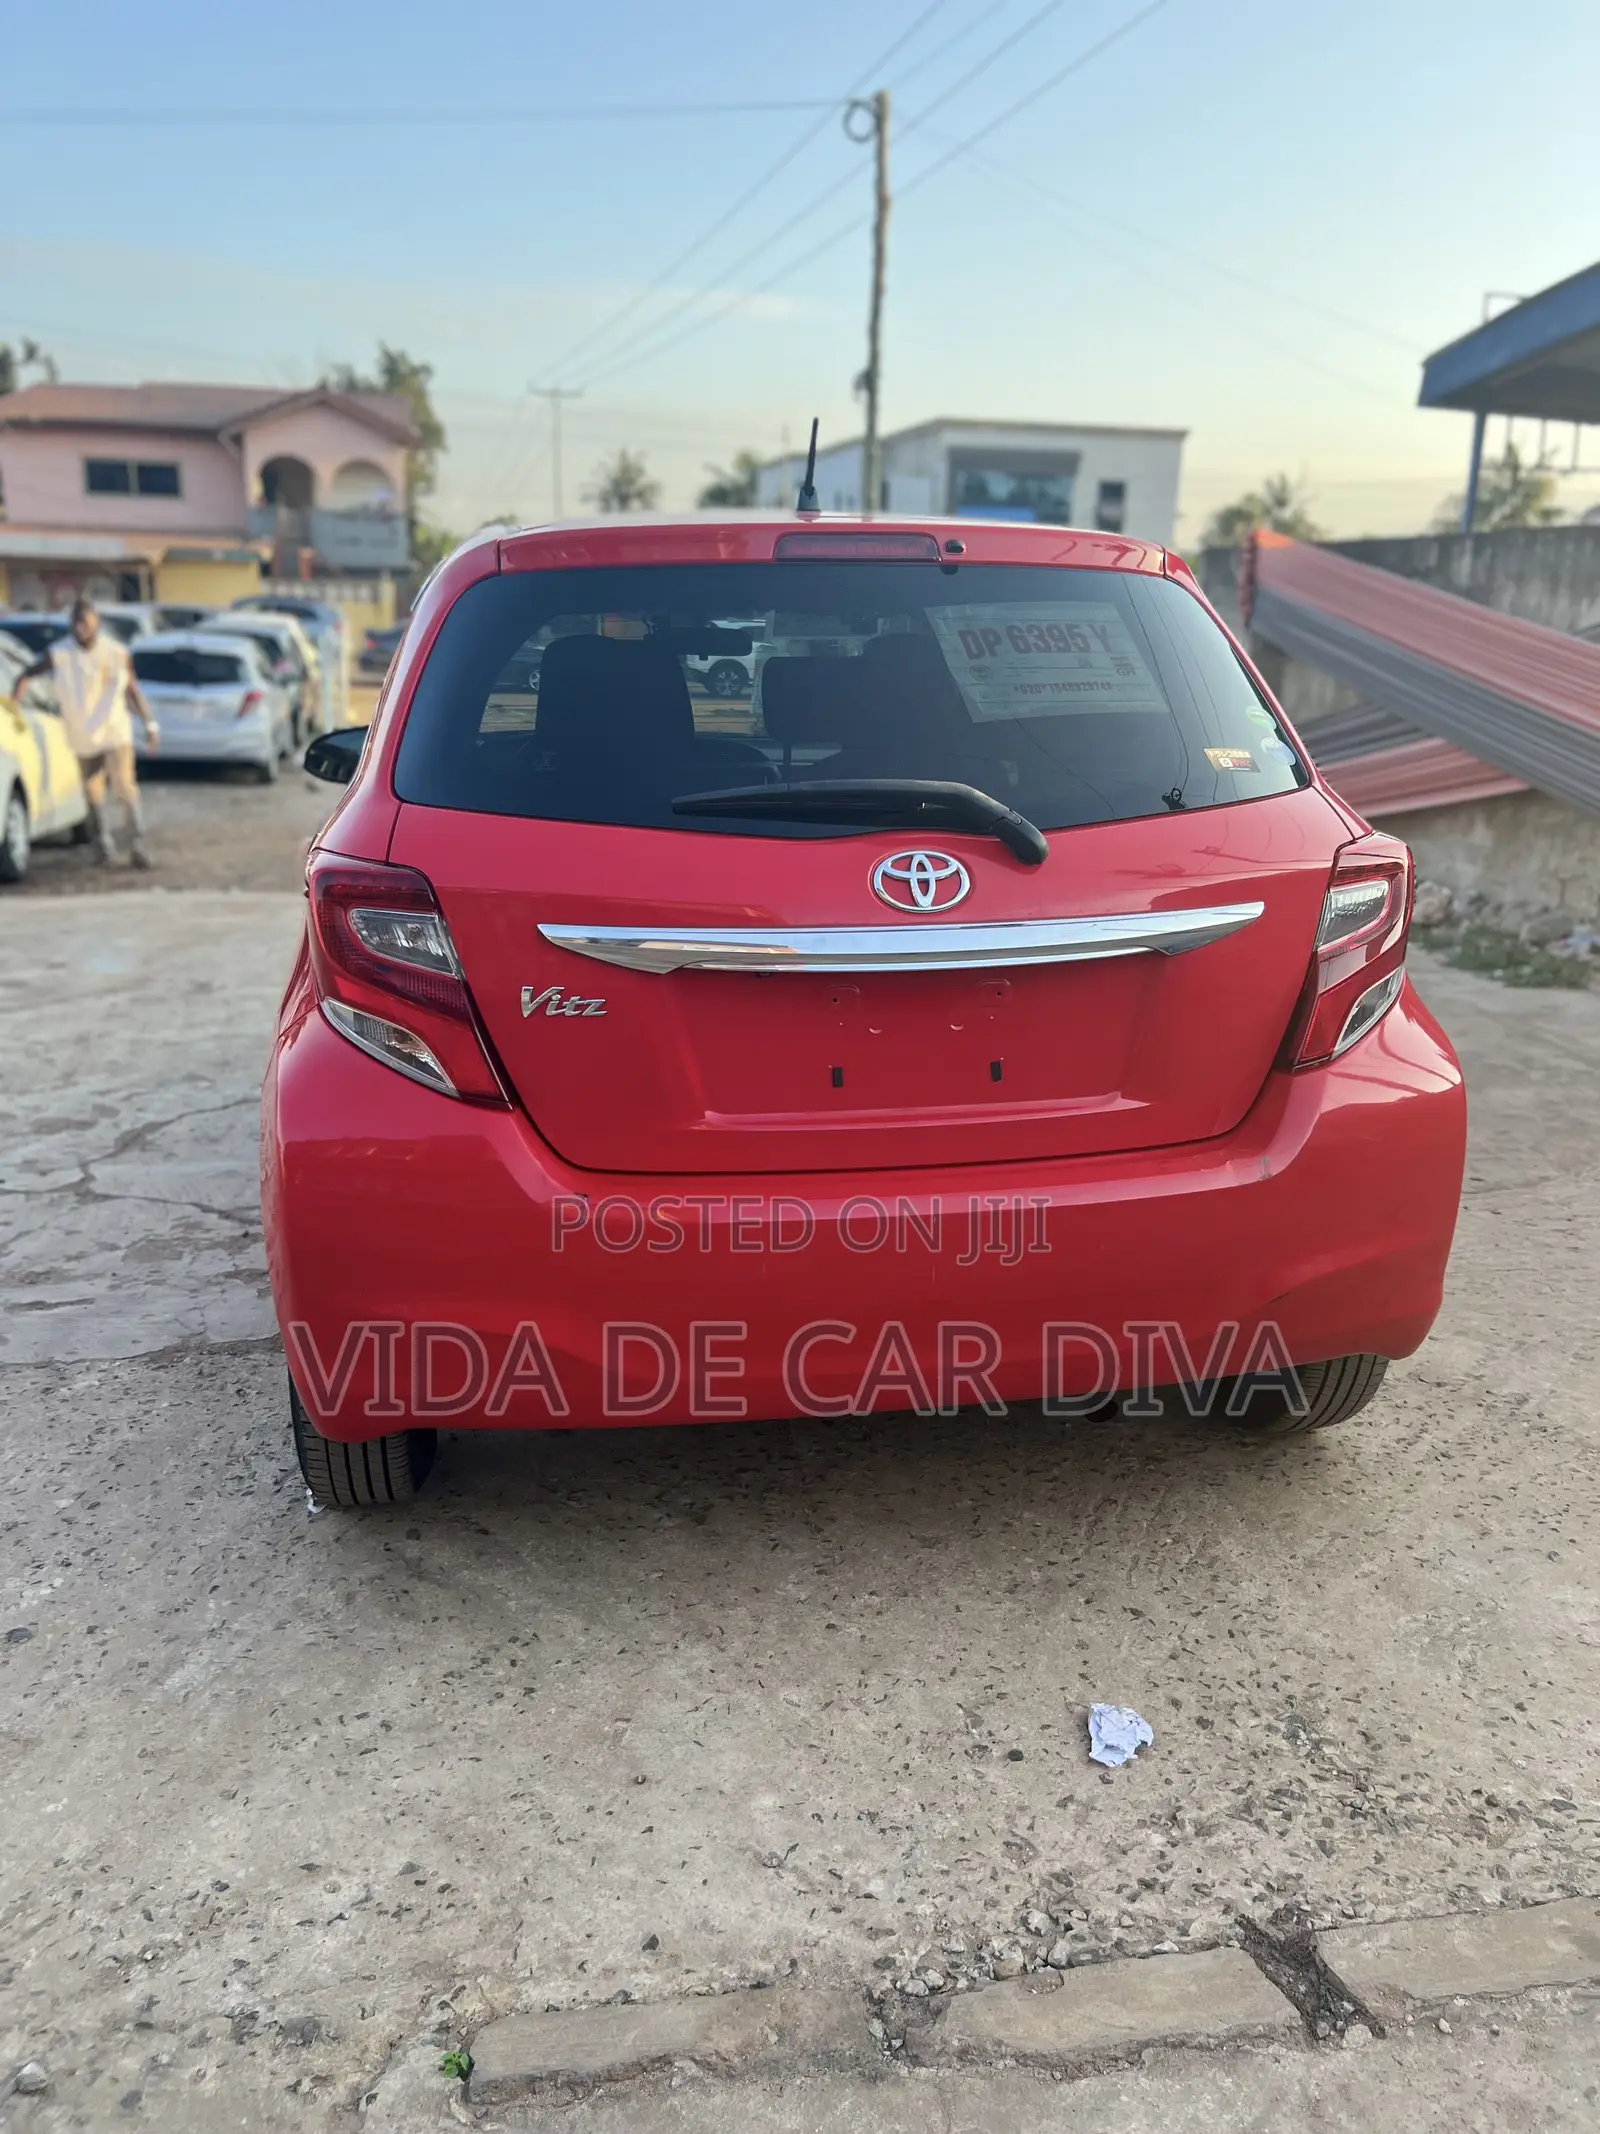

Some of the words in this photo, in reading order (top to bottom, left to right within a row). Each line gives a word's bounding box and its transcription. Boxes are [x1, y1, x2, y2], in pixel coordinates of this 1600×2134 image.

[957, 628, 1003, 660] DP
[1005, 624, 1091, 654] 6395
[1087, 624, 1113, 651] Y
[521, 986, 608, 1018] Vitz
